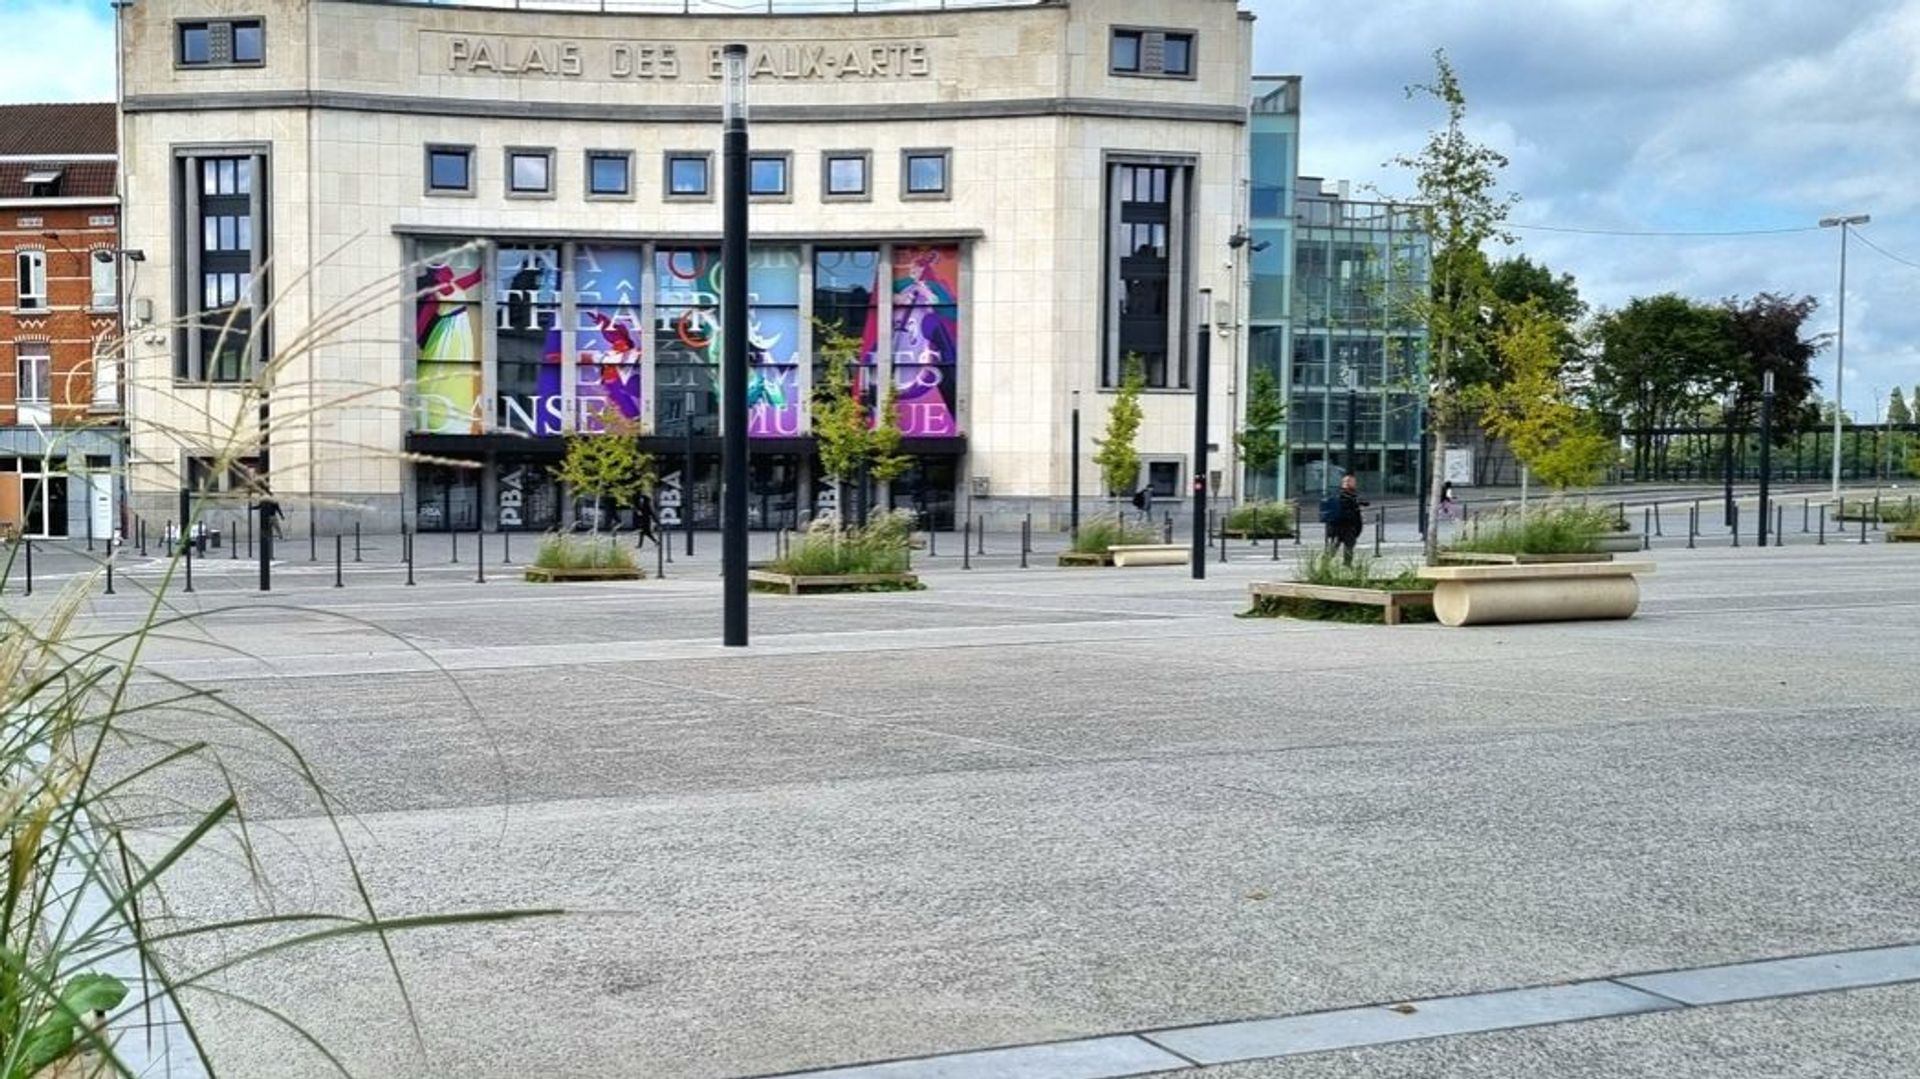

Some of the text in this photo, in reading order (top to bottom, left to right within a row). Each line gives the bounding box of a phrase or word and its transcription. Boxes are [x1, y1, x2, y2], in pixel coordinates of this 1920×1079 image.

[449, 36, 930, 79] PALAIS DES BAUX-ARTS
[659, 470, 684, 526] PBA
